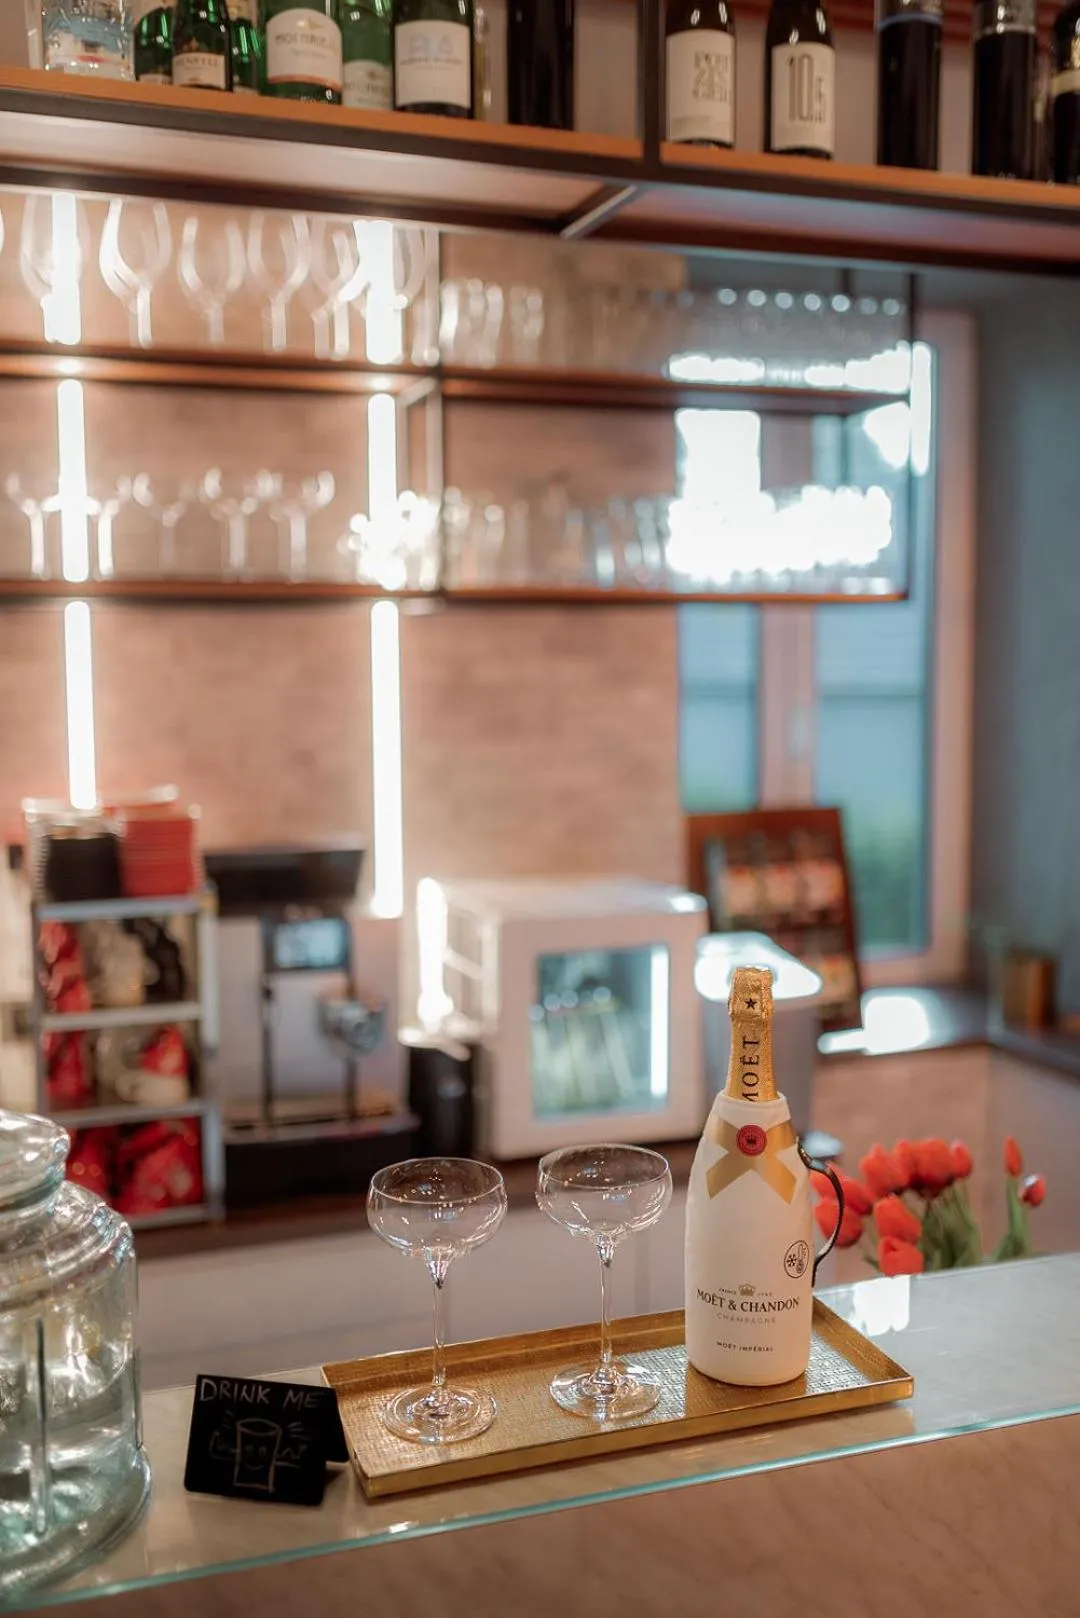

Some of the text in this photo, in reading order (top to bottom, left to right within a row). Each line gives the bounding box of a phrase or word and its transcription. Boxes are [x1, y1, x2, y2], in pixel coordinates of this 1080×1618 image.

[728, 1299, 737, 1311] &
[740, 1296, 799, 1312] CHANDON
[716, 1312, 776, 1324] CHAMPAGNE
[200, 1378, 324, 1410] DRINK ME
